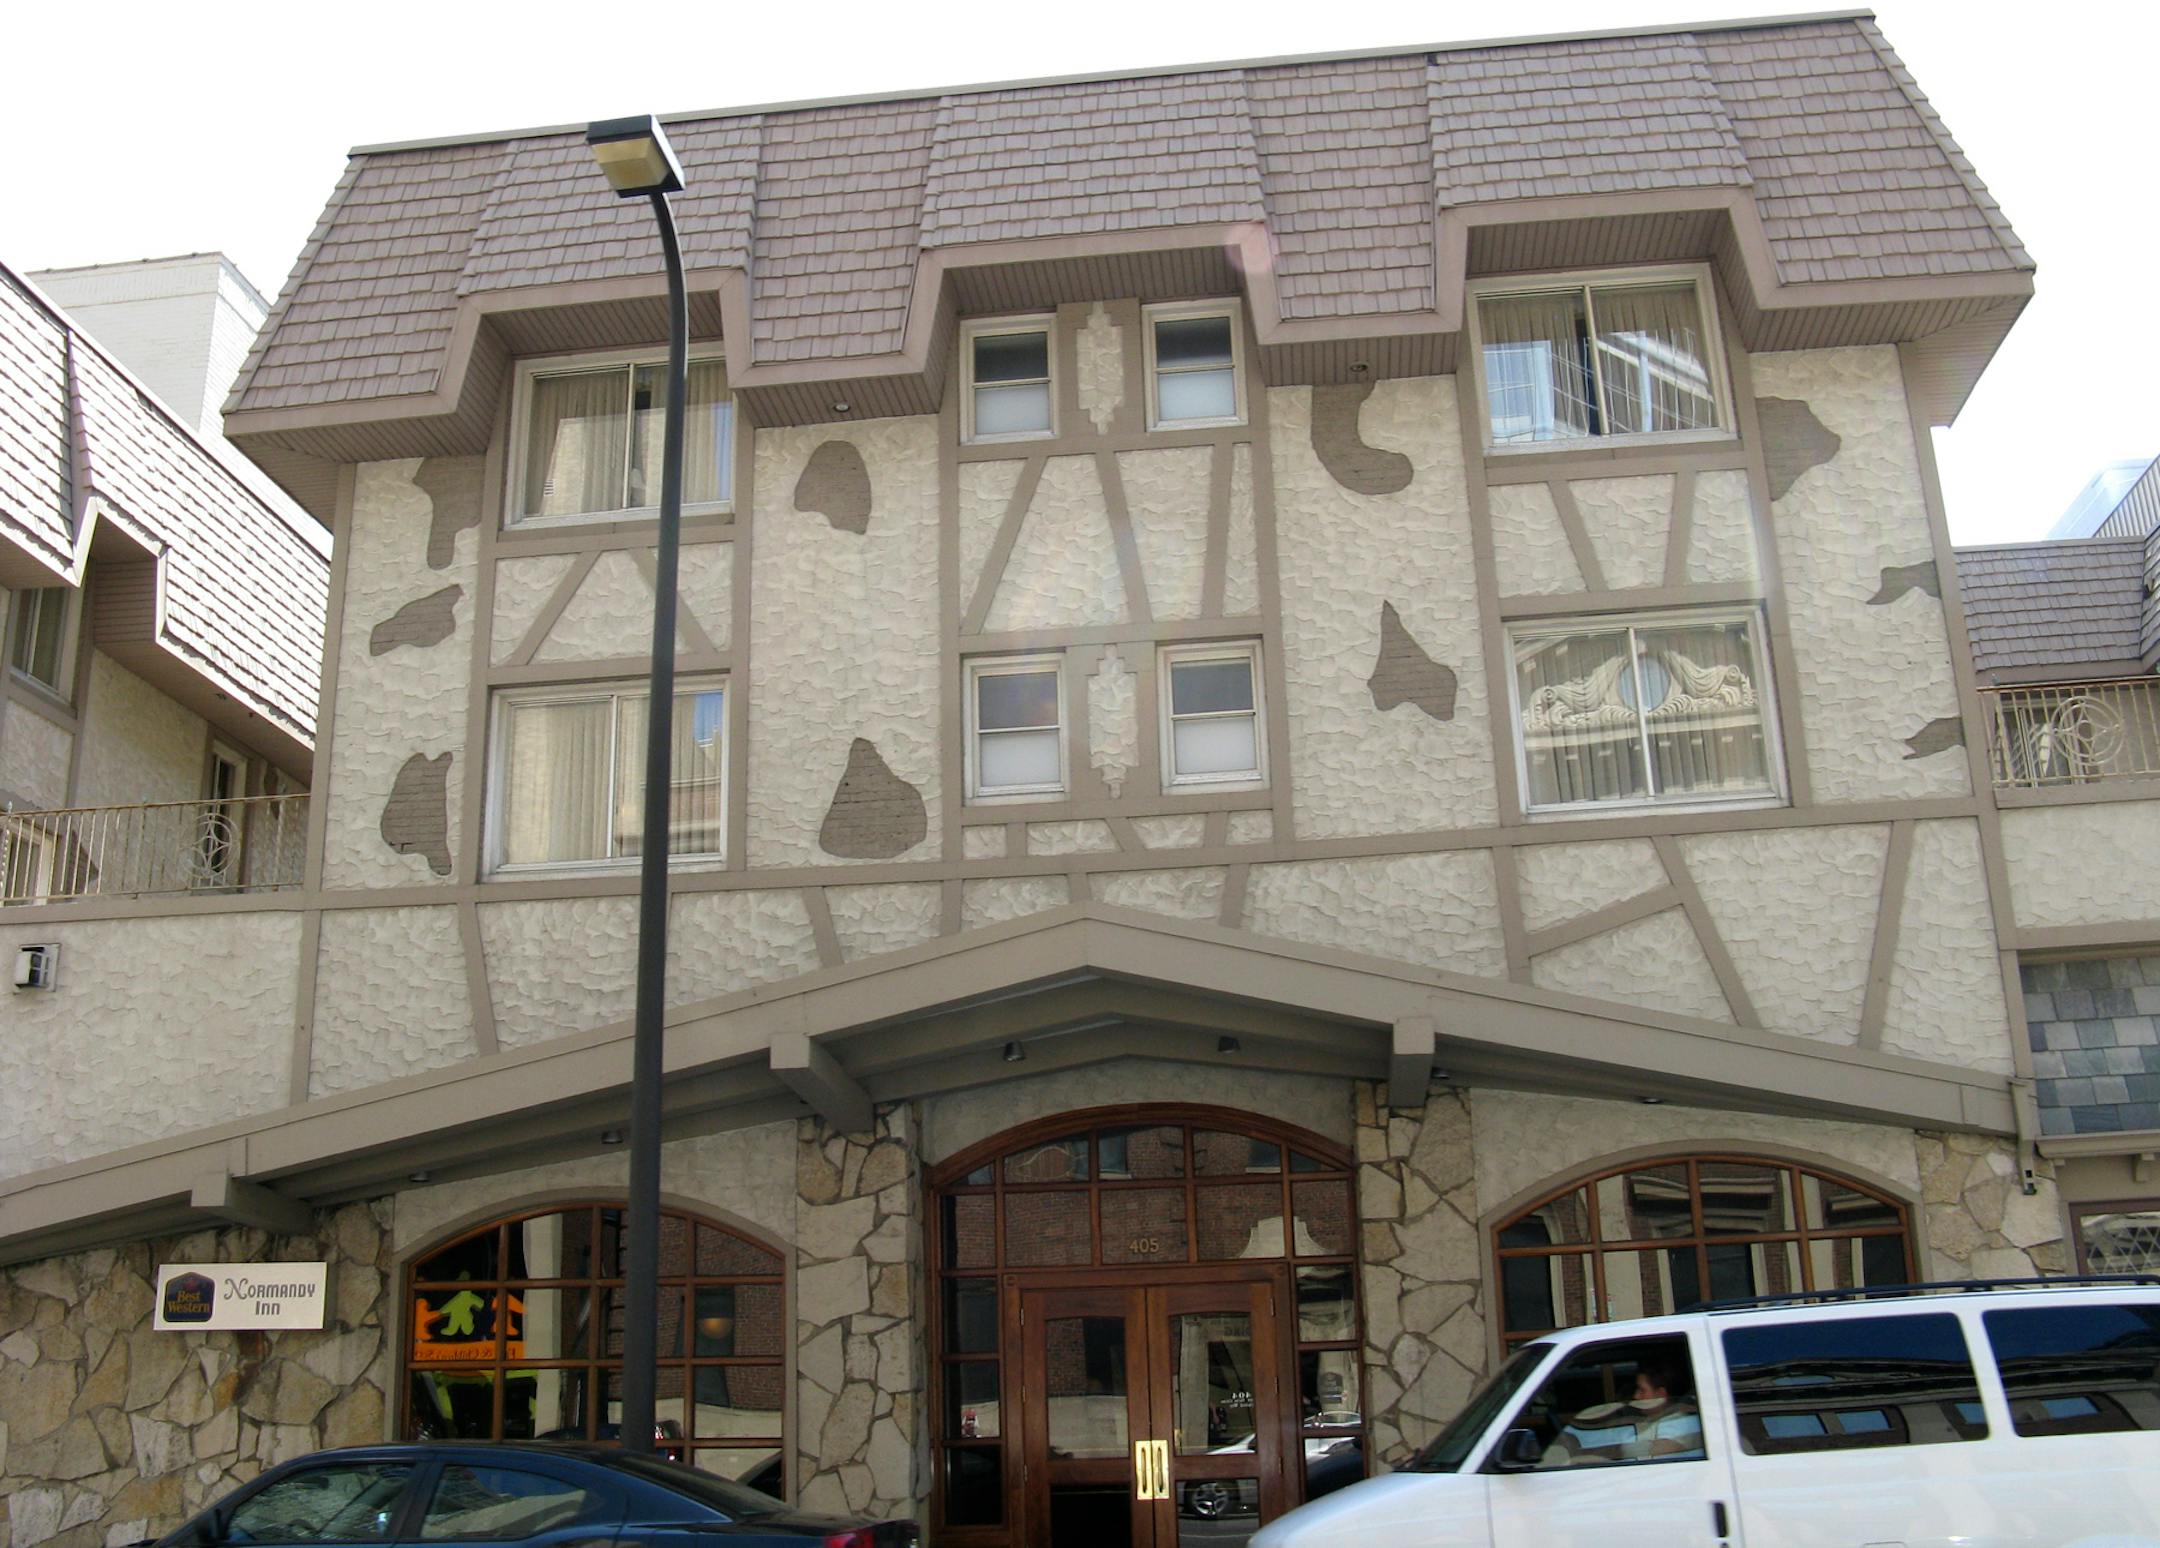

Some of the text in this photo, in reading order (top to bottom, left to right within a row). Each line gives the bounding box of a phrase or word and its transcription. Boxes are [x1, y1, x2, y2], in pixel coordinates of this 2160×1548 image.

[1129, 1238, 1159, 1253] 405
[176, 1291, 201, 1301] Best
[223, 1278, 316, 1300] NORMANDY
[167, 1302, 210, 1313] Western
[255, 1301, 281, 1315] Inn
